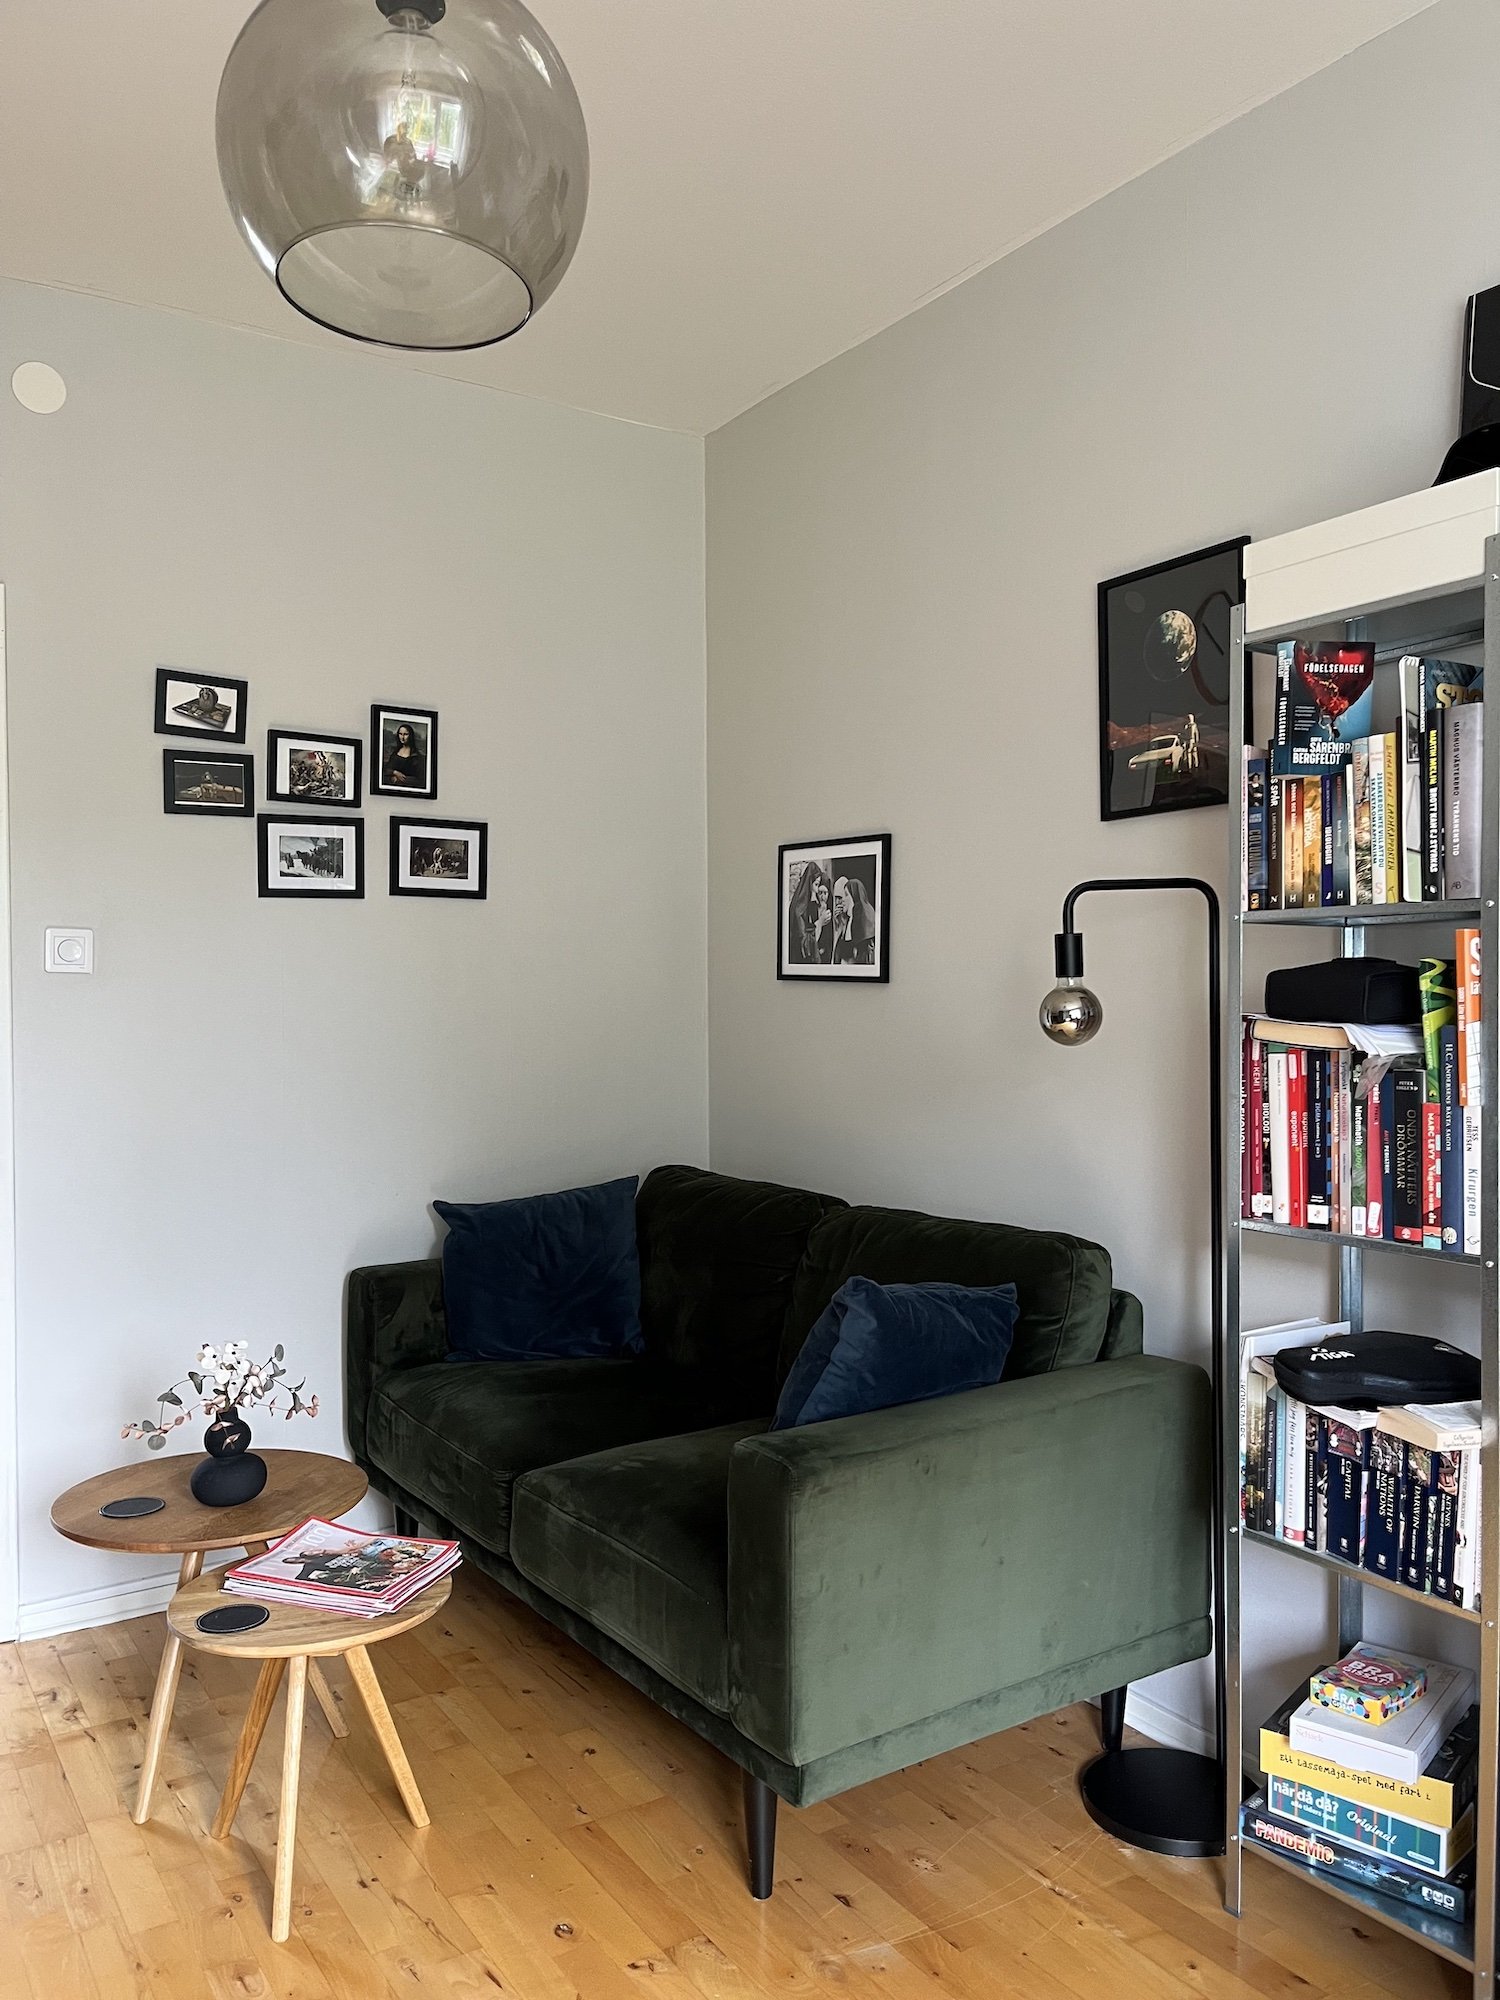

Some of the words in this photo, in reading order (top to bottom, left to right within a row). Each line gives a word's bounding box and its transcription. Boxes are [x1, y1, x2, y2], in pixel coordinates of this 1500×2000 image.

[1303, 662, 1365, 674] FÖDELSEDAGEN
[1293, 753, 1341, 765] BERGFELDT
[1309, 741, 1352, 754] SARENBR
[1428, 729, 1437, 757] MARTIN
[1428, 758, 1437, 785] MELIN
[1453, 754, 1461, 796] VÄSTERBRO
[1428, 787, 1437, 812] BROTT
[1428, 813, 1437, 828] KAN
[1428, 828, 1437, 838] EJ
[1452, 800, 1460, 842] TYRANNENS
[1324, 826, 1332, 865] IDEOLOGIER
[1428, 838, 1437, 873] STYRKAS
[1452, 843, 1460, 856] TID
[1378, 858, 1384, 868] DU
[1445, 1063, 1453, 1105] ANDERSENS
[1290, 1110, 1299, 1147] exponent
[1332, 1092, 1340, 1135] Naturkunskap
[1340, 1093, 1348, 1136] Naturkunskap
[1354, 1105, 1363, 1146] Matematik
[1406, 1110, 1417, 1145] ONDA
[1427, 1113, 1435, 1137] MARC
[1445, 1106, 1453, 1127] BÄSTA
[1396, 1124, 1407, 1189] DRÖMMAR
[1427, 1138, 1435, 1160] LEVY
[1445, 1128, 1453, 1152] SAGOR
[1354, 1146, 1363, 1169] 5000
[1406, 1149, 1418, 1206] NÄTTERS
[1466, 1168, 1479, 1217] Kirurgen
[1428, 1212, 1437, 1225] du
[1344, 1460, 1352, 1500] CAPITAL
[1378, 1472, 1388, 1516] NATIONS
[1387, 1476, 1395, 1518] WEALTH
[1412, 1485, 1421, 1529] DARWIN
[1444, 1495, 1452, 1527] KEYNES
[1386, 1518, 1393, 1533] OF
[1348, 1660, 1394, 1681] BRA
[1335, 1692, 1355, 1705] BRA
[1279, 1754, 1293, 1764] Ett
[1376, 1780, 1395, 1791] med
[1399, 1785, 1421, 1798] fart
[1273, 1781, 1295, 1797] när
[1296, 1789, 1313, 1805] då
[1315, 1796, 1339, 1814] då?
[1255, 1818, 1335, 1865] PANDEMIC
[1346, 1810, 1398, 1845] Original
